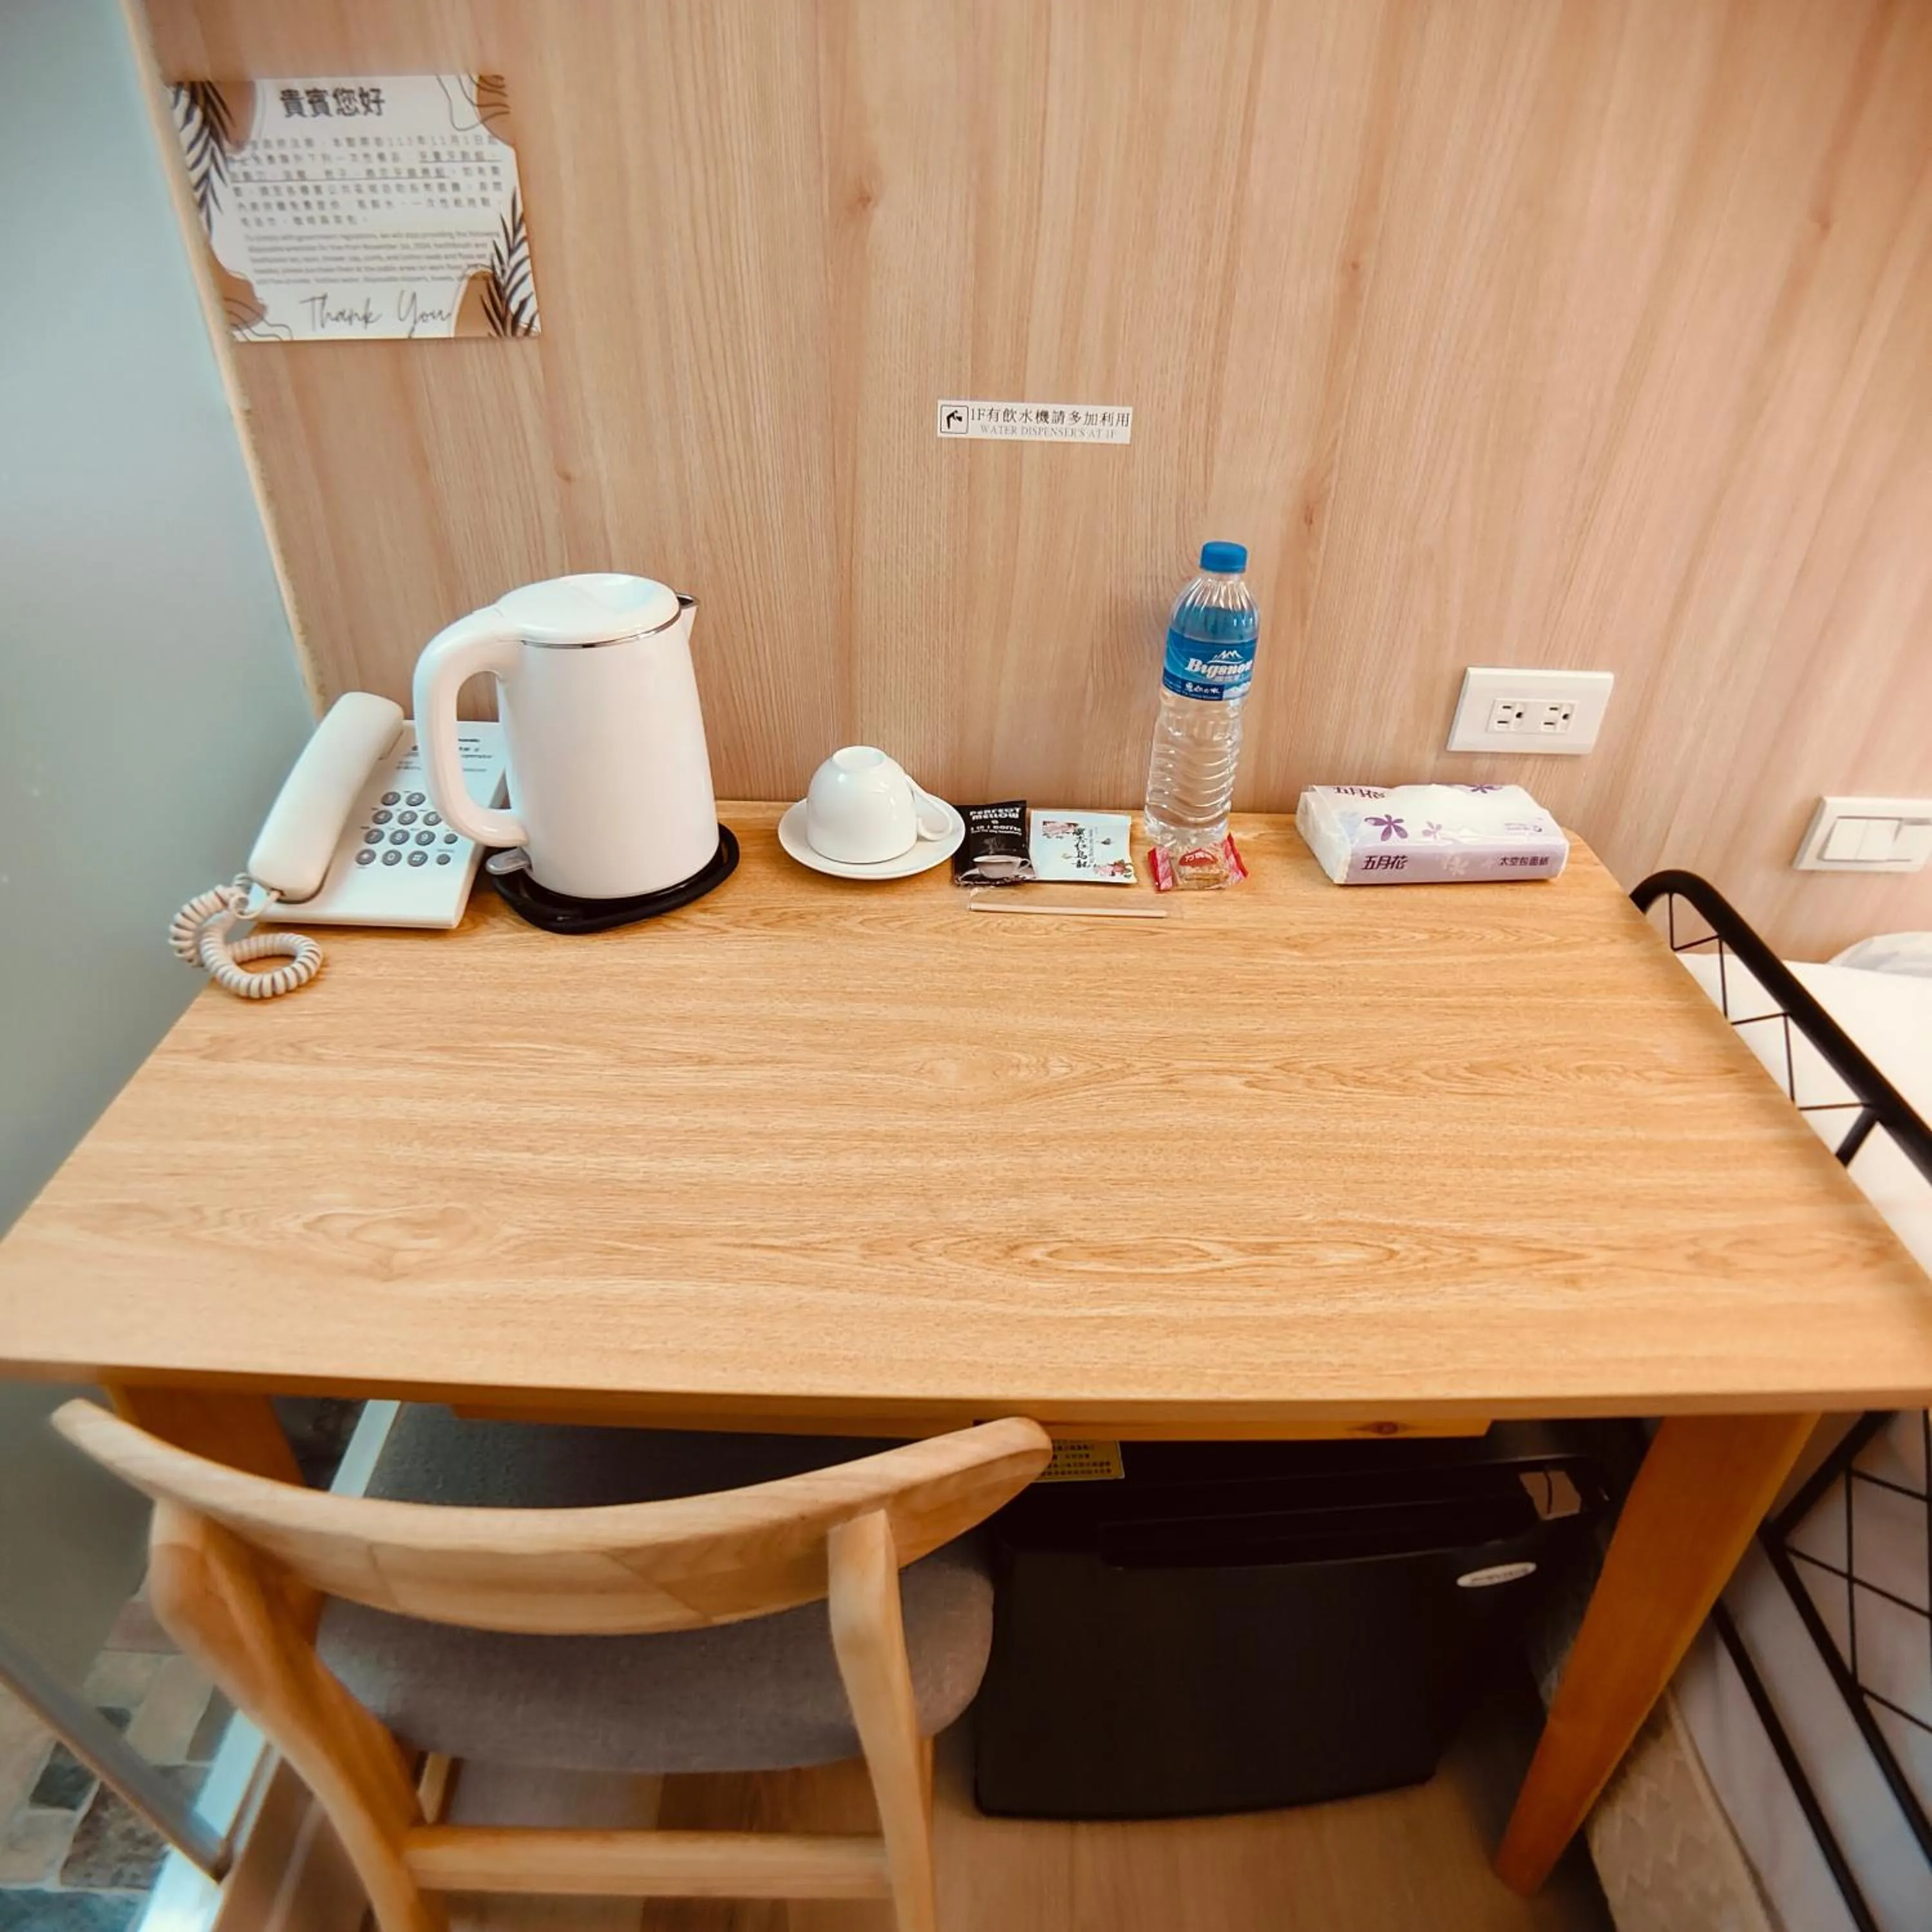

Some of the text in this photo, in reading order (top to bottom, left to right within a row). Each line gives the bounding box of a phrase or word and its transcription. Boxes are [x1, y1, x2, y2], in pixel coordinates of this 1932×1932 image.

[279, 86, 385, 118] 貴賓您好
[299, 289, 452, 339] Thank You
[971, 407, 1130, 428] 1F有飲水機請多加利用
[980, 424, 1018, 436] WATER
[1361, 855, 1408, 870] 五月花
